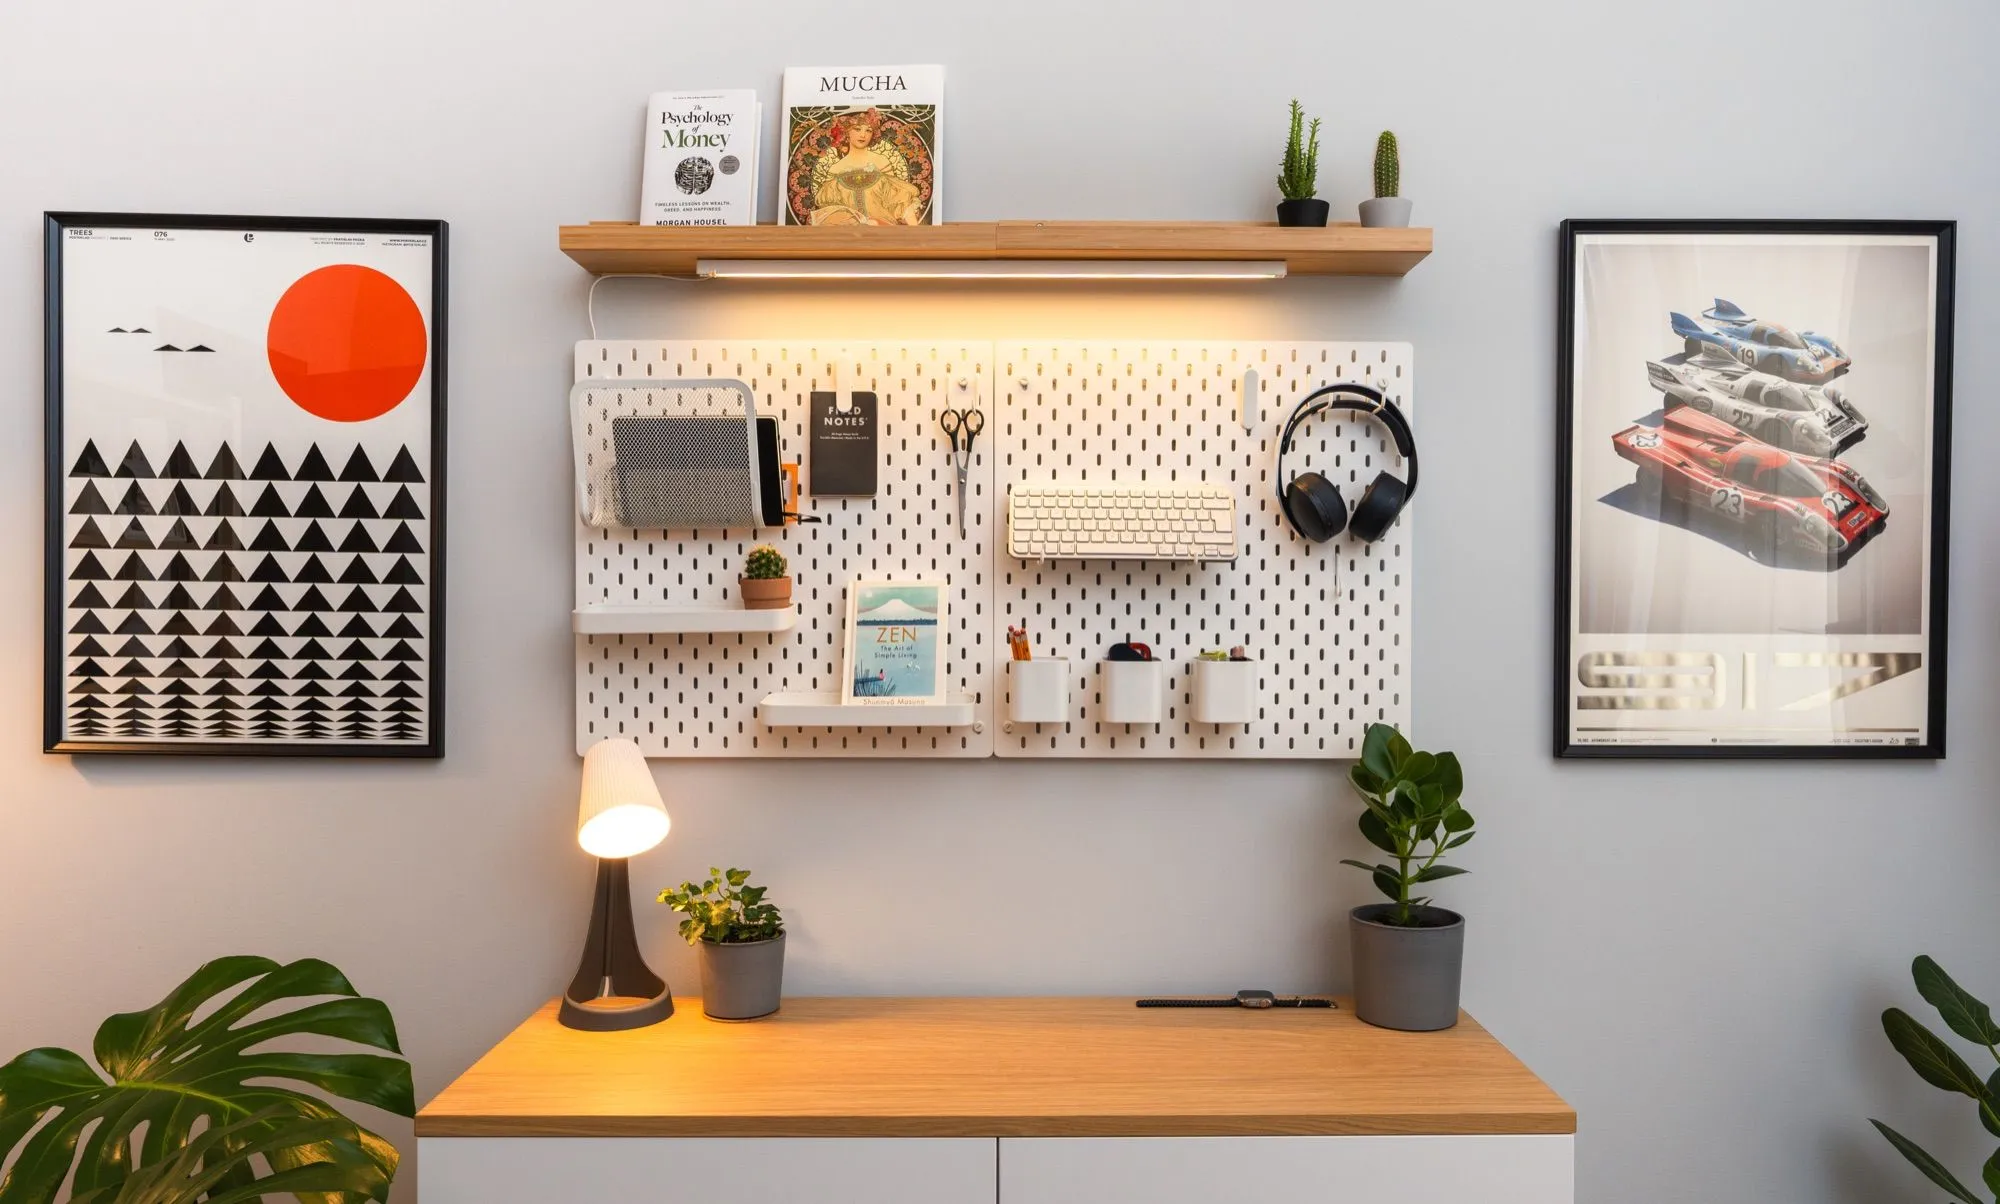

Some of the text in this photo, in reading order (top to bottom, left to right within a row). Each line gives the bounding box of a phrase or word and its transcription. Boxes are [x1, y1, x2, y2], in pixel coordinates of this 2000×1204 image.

[819, 75, 907, 92] MUCHA
[661, 111, 734, 127] Psychology
[692, 125, 700, 134] of
[661, 129, 731, 152] Money
[694, 218, 727, 226] HOUSEL
[1740, 347, 1755, 362] 19
[824, 417, 865, 426] NOTES
[1717, 488, 1742, 516] 23
[877, 626, 917, 643] ZEN
[1577, 652, 1922, 711] 917
